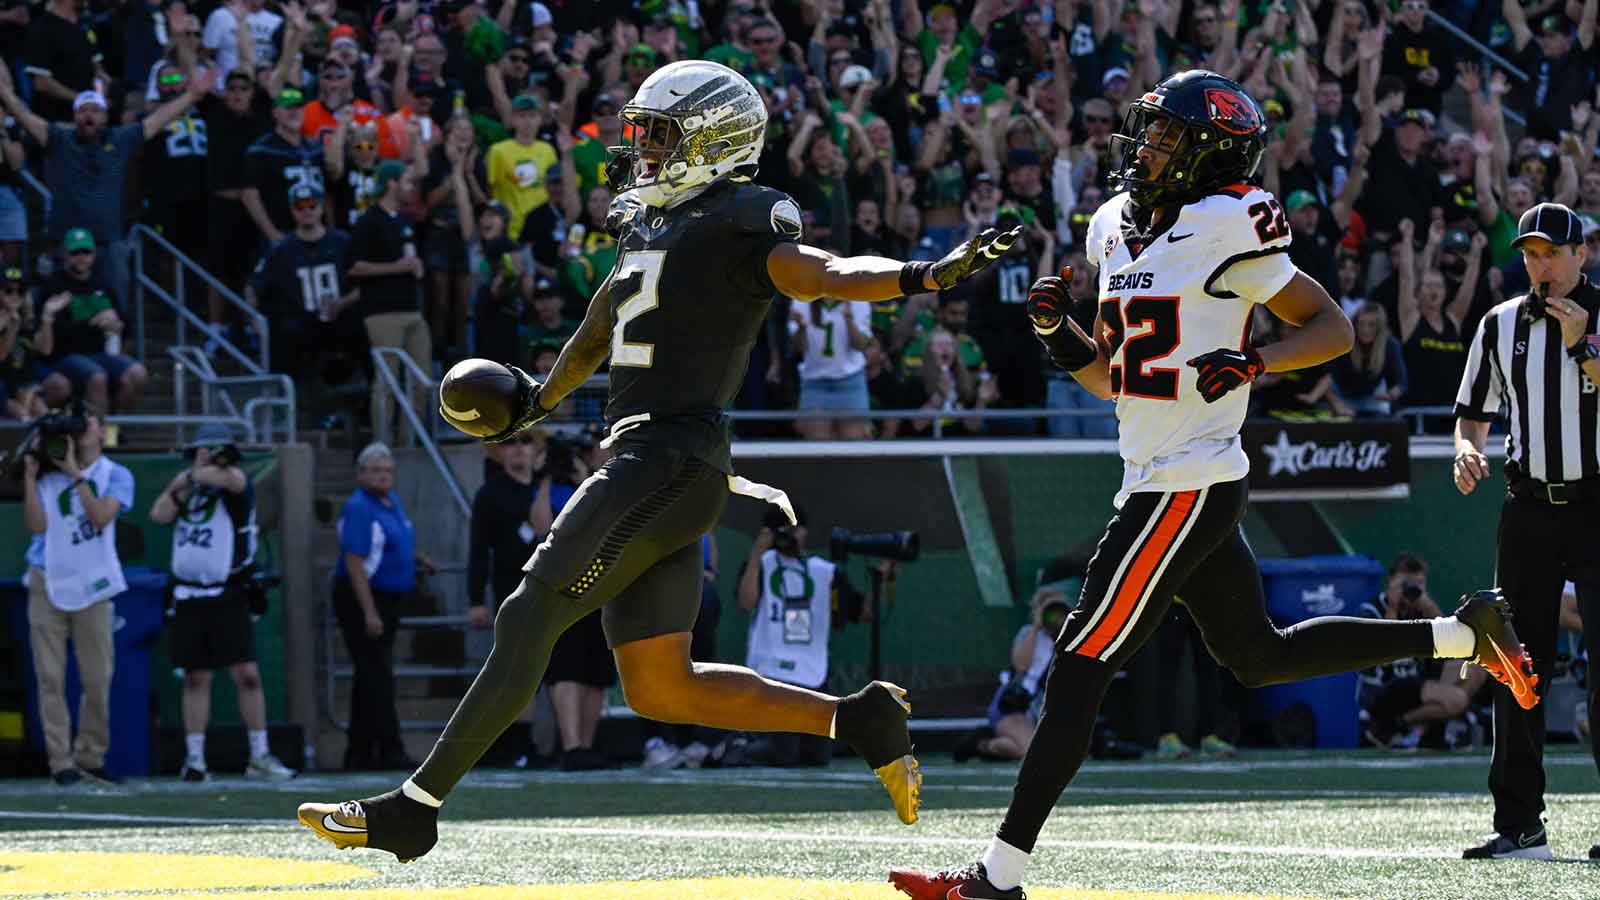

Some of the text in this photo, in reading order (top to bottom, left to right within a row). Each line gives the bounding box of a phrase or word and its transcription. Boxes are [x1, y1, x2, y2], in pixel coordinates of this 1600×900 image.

[1248, 199, 1290, 244] 22
[1107, 272, 1154, 292] BEAVS
[610, 250, 668, 368] 2
[1515, 341, 1527, 355] S
[1297, 440, 1388, 472] Carl's Jr.
